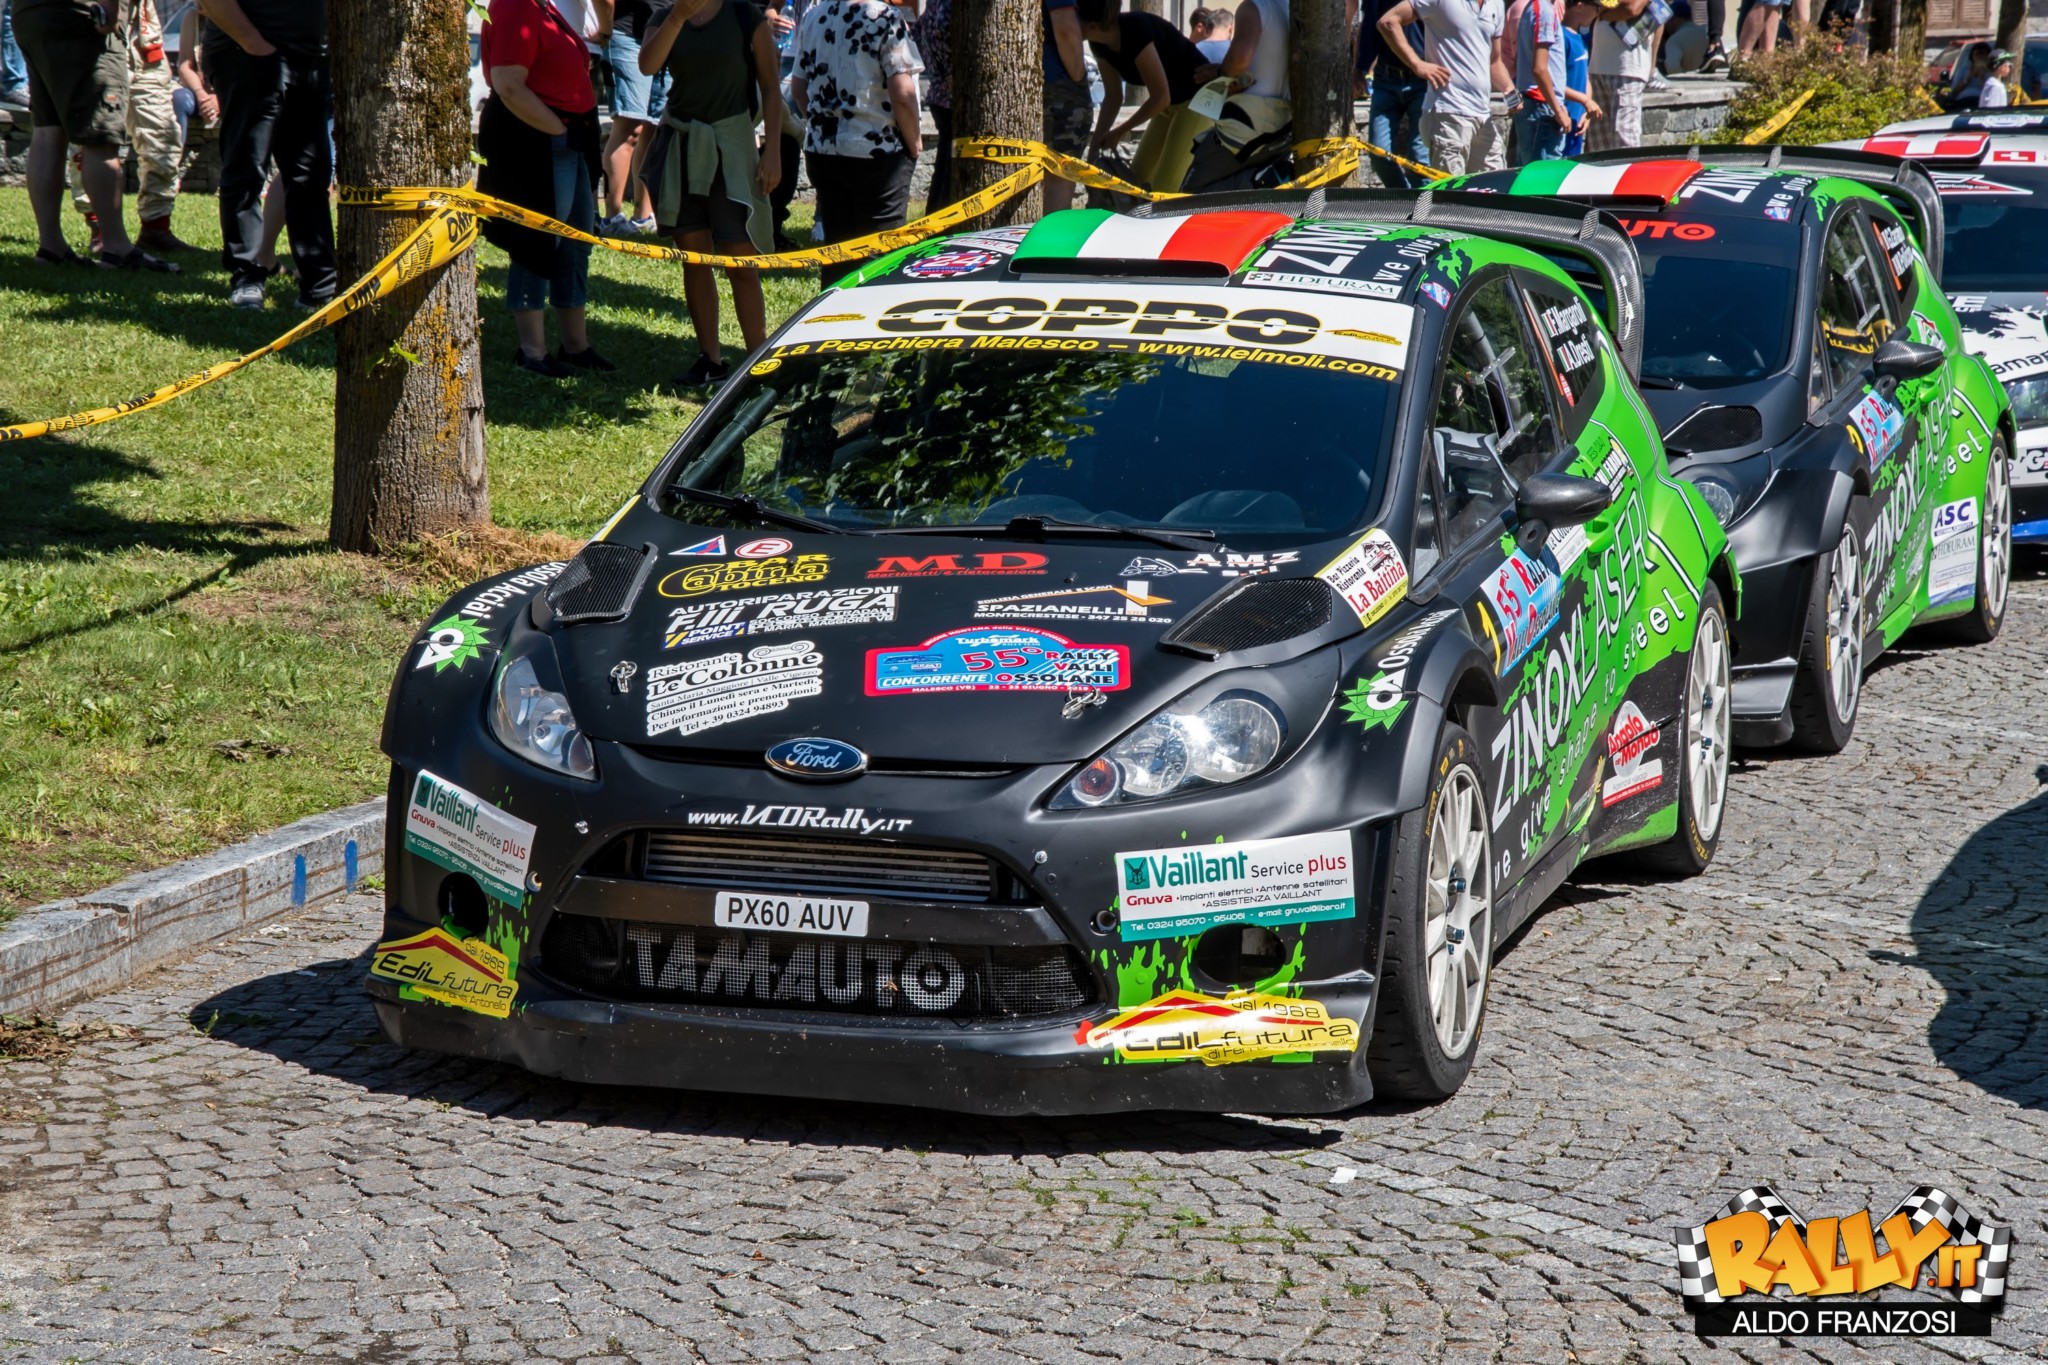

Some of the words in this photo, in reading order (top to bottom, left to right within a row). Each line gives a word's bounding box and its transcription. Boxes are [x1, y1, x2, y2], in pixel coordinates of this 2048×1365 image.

[1680, 168, 1774, 204] ZINO
[1766, 193, 1793, 207] we
[1619, 219, 1715, 241] UTO
[1253, 223, 1391, 275] ZINO
[1278, 274, 1393, 294] FIDEURAM
[1373, 261, 1410, 282] we
[876, 297, 1321, 345] COPPO
[772, 345, 803, 359] La
[818, 336, 963, 354] Peschiera
[971, 336, 1099, 349] Malesco
[1138, 342, 1398, 381] www.ielmoli.com
[1935, 501, 1971, 529] ASC
[727, 554, 831, 569] BAR
[1186, 550, 1301, 566] AMZ
[1326, 574, 1340, 583] Bar
[1336, 556, 1360, 576] Pizzeria
[720, 574, 825, 591] TOCENO
[957, 568, 1047, 576] ristorazione
[1336, 567, 1367, 592] Ristorante
[977, 595, 1020, 605] EDILIZIA
[1021, 588, 1073, 599] GENERALE
[1348, 593, 1371, 614] La
[1364, 561, 1405, 602] Baitina
[460, 581, 527, 620] Acciai
[669, 586, 899, 616] AUTORIPARAZIONI
[757, 594, 896, 619] RUGA
[977, 604, 1124, 616] SPAZIANELLI
[750, 612, 820, 625] SOCCORSO
[825, 607, 894, 618] STRADALE
[764, 622, 803, 632] MARIA
[809, 618, 870, 627] MAGGIORE
[974, 612, 1079, 620] MONTECRESTESE
[681, 631, 732, 646] SERVICE
[688, 622, 745, 638] POINT
[653, 654, 738, 678] Ristorante
[961, 646, 1043, 672] 55°
[1045, 652, 1111, 660] RALLY
[1054, 663, 1112, 671] VALLI
[1491, 490, 1657, 833] ZINOXLASER
[652, 681, 679, 696] Le
[686, 654, 818, 686] Colonne
[882, 674, 987, 687] CONCORRENTE
[996, 673, 1113, 684] OSSOLANE
[651, 698, 675, 709] Santa
[677, 691, 703, 702] Maria
[706, 681, 748, 695] Maggiore
[757, 674, 780, 683] Valle
[782, 669, 818, 679] Vigezzo
[912, 685, 953, 693] MALESCO
[652, 709, 687, 721] Chiuso
[699, 693, 735, 706] Lunedì
[738, 688, 760, 698] sera
[652, 722, 668, 732] Per
[671, 701, 737, 725] informazioni
[748, 687, 817, 706] prenotazioni:
[684, 722, 699, 732] Tel
[712, 715, 724, 724] 39
[726, 709, 750, 719] 0324
[753, 700, 784, 712] 94893
[1520, 784, 1551, 860] give
[1558, 702, 1598, 786] shape
[1604, 668, 1617, 705] to
[1623, 588, 1686, 672] steel
[1609, 713, 1644, 755] Angolo
[786, 741, 841, 770] Ford
[411, 808, 436, 829] Gnuva
[429, 780, 479, 833] Vaillant
[475, 824, 501, 850] Service
[501, 838, 526, 860] plus
[1149, 851, 1248, 888] Vaillant
[1251, 862, 1304, 878] Service
[1307, 854, 1347, 877] plus
[1127, 895, 1173, 906] Gnuva
[1180, 891, 1216, 902] Impianti
[1218, 887, 1253, 898] elettrici
[1258, 883, 1300, 893] Antenne
[1303, 877, 1348, 889] satellitari
[1205, 894, 1272, 908] ASSISTENZA
[1274, 889, 1322, 900] VAILLANT
[727, 898, 789, 926] PX60
[800, 902, 854, 931] AUV
[1130, 923, 1145, 931] Tel.
[1147, 920, 1174, 930] 0324
[1175, 916, 1206, 927] 95070
[465, 941, 478, 956] dal
[480, 949, 505, 975] 1968
[628, 925, 965, 1010] TAMAUTO
[1262, 1001, 1320, 1018] 1968
